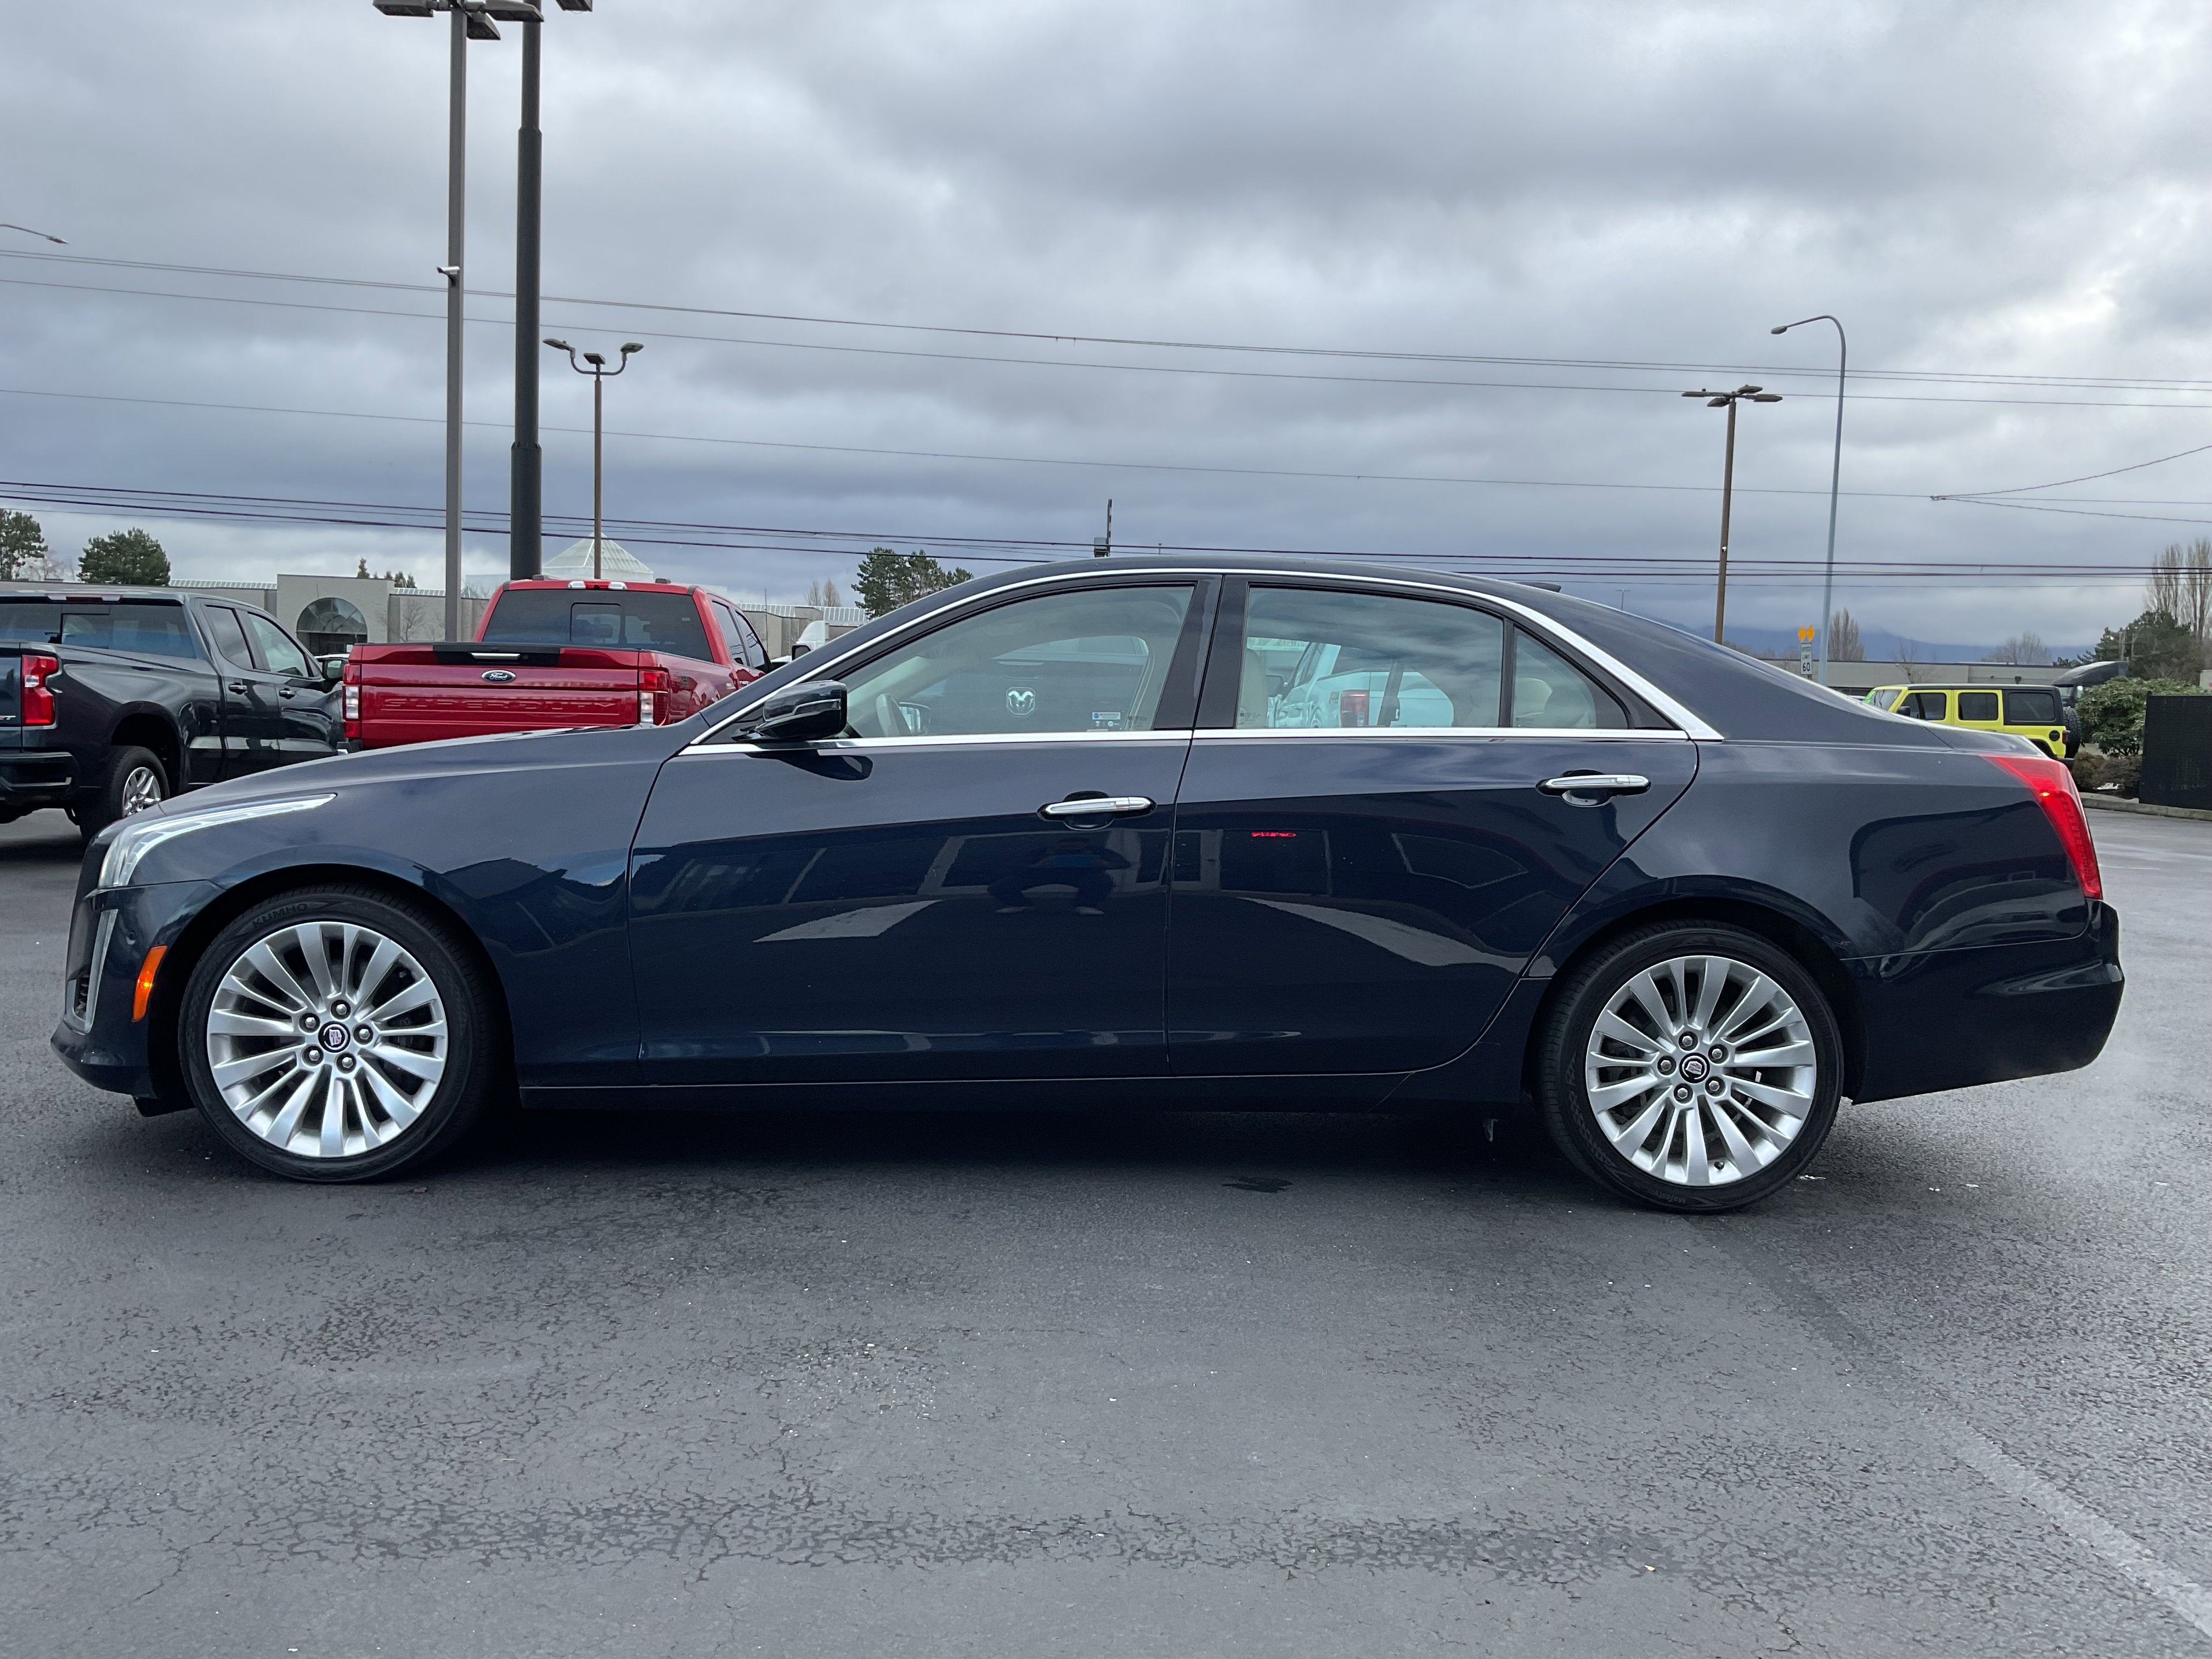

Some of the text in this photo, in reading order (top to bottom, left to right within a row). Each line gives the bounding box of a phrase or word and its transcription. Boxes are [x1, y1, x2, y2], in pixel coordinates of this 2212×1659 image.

[1802, 662, 1810, 672] 60
[489, 672, 508, 680] Ford
[252, 903, 308, 928] KUMHO
